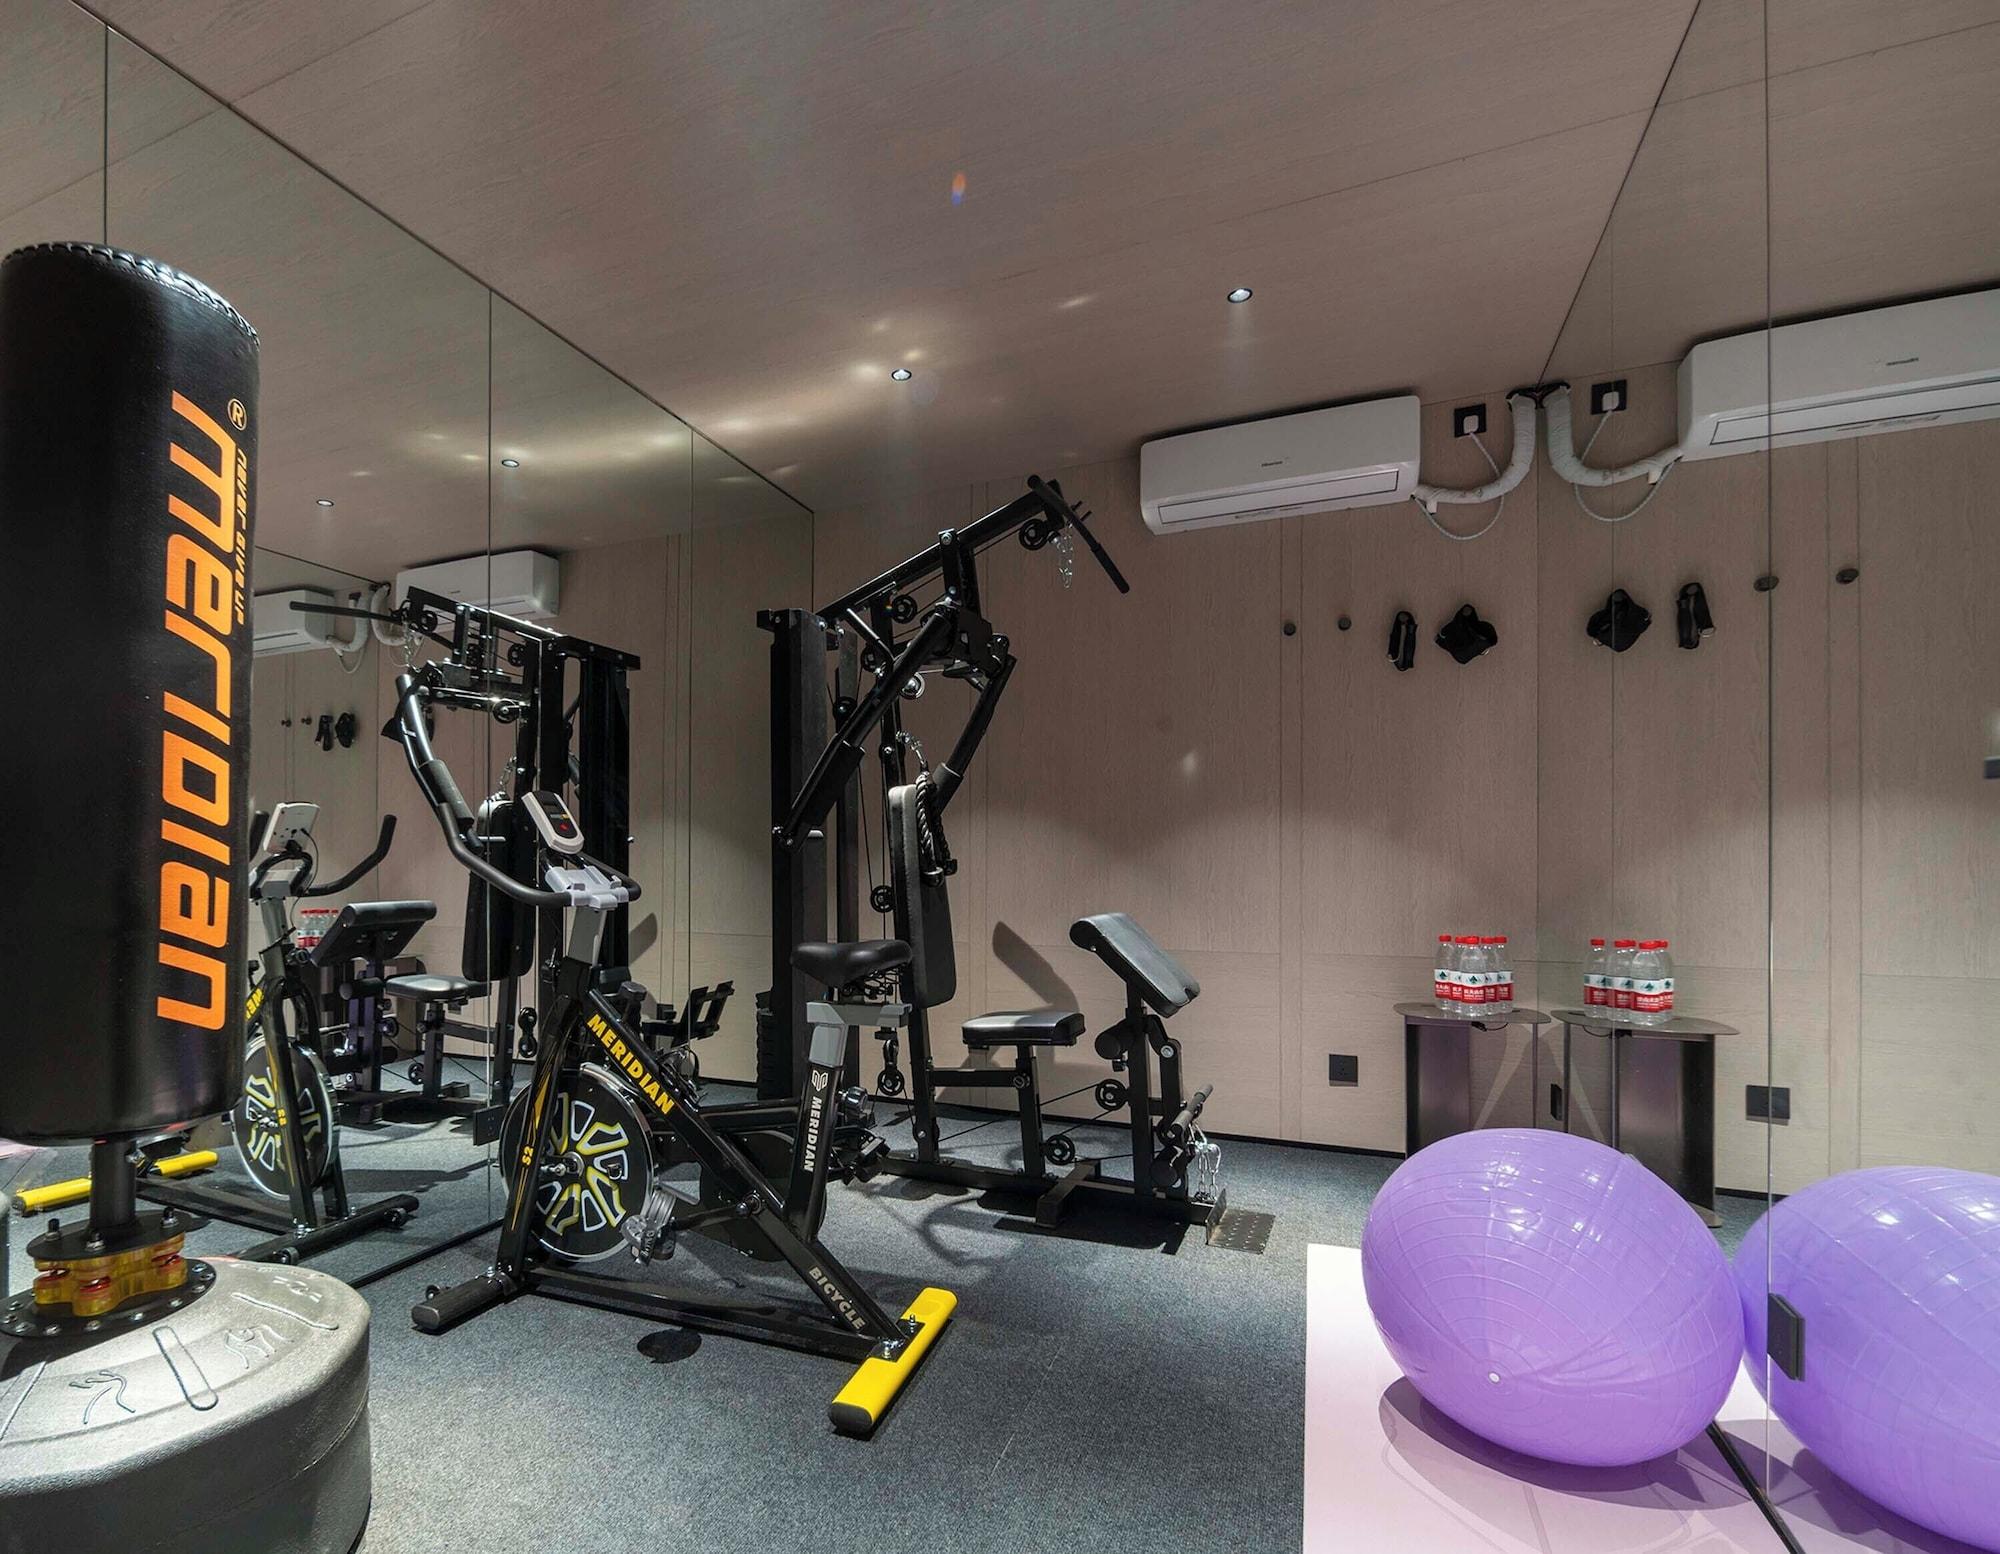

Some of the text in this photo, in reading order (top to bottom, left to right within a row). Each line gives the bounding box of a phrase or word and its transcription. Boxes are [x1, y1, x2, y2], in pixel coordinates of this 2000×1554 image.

[587, 1014, 675, 1115] MERIDIAN
[522, 1146, 534, 1166] S2
[803, 1096, 823, 1173] MERIDIAN
[809, 1266, 866, 1331] BICYCLE
